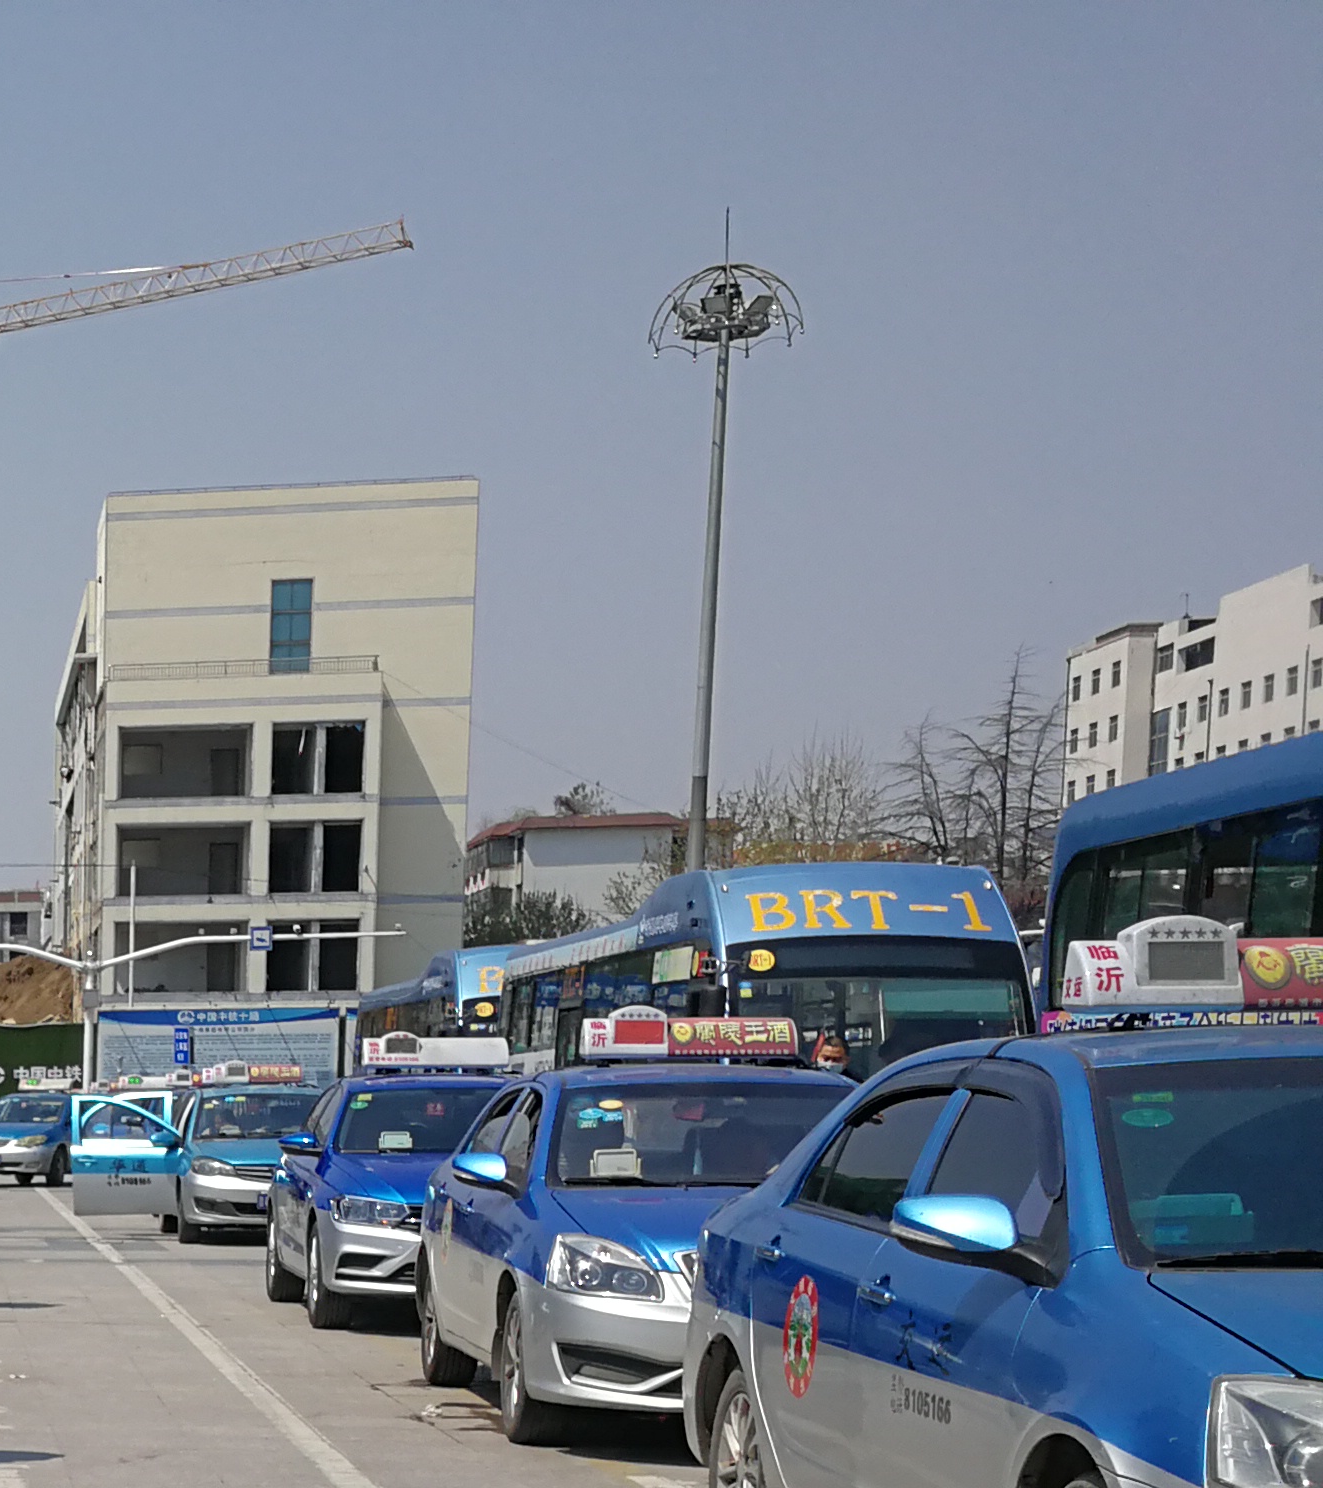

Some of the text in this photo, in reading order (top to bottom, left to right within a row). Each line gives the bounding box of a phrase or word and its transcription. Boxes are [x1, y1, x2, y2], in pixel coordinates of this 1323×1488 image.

[1086, 944, 1125, 993] 临沂
[13, 1065, 83, 1082] 中国中铁
[904, 1387, 952, 1425] 8105166
